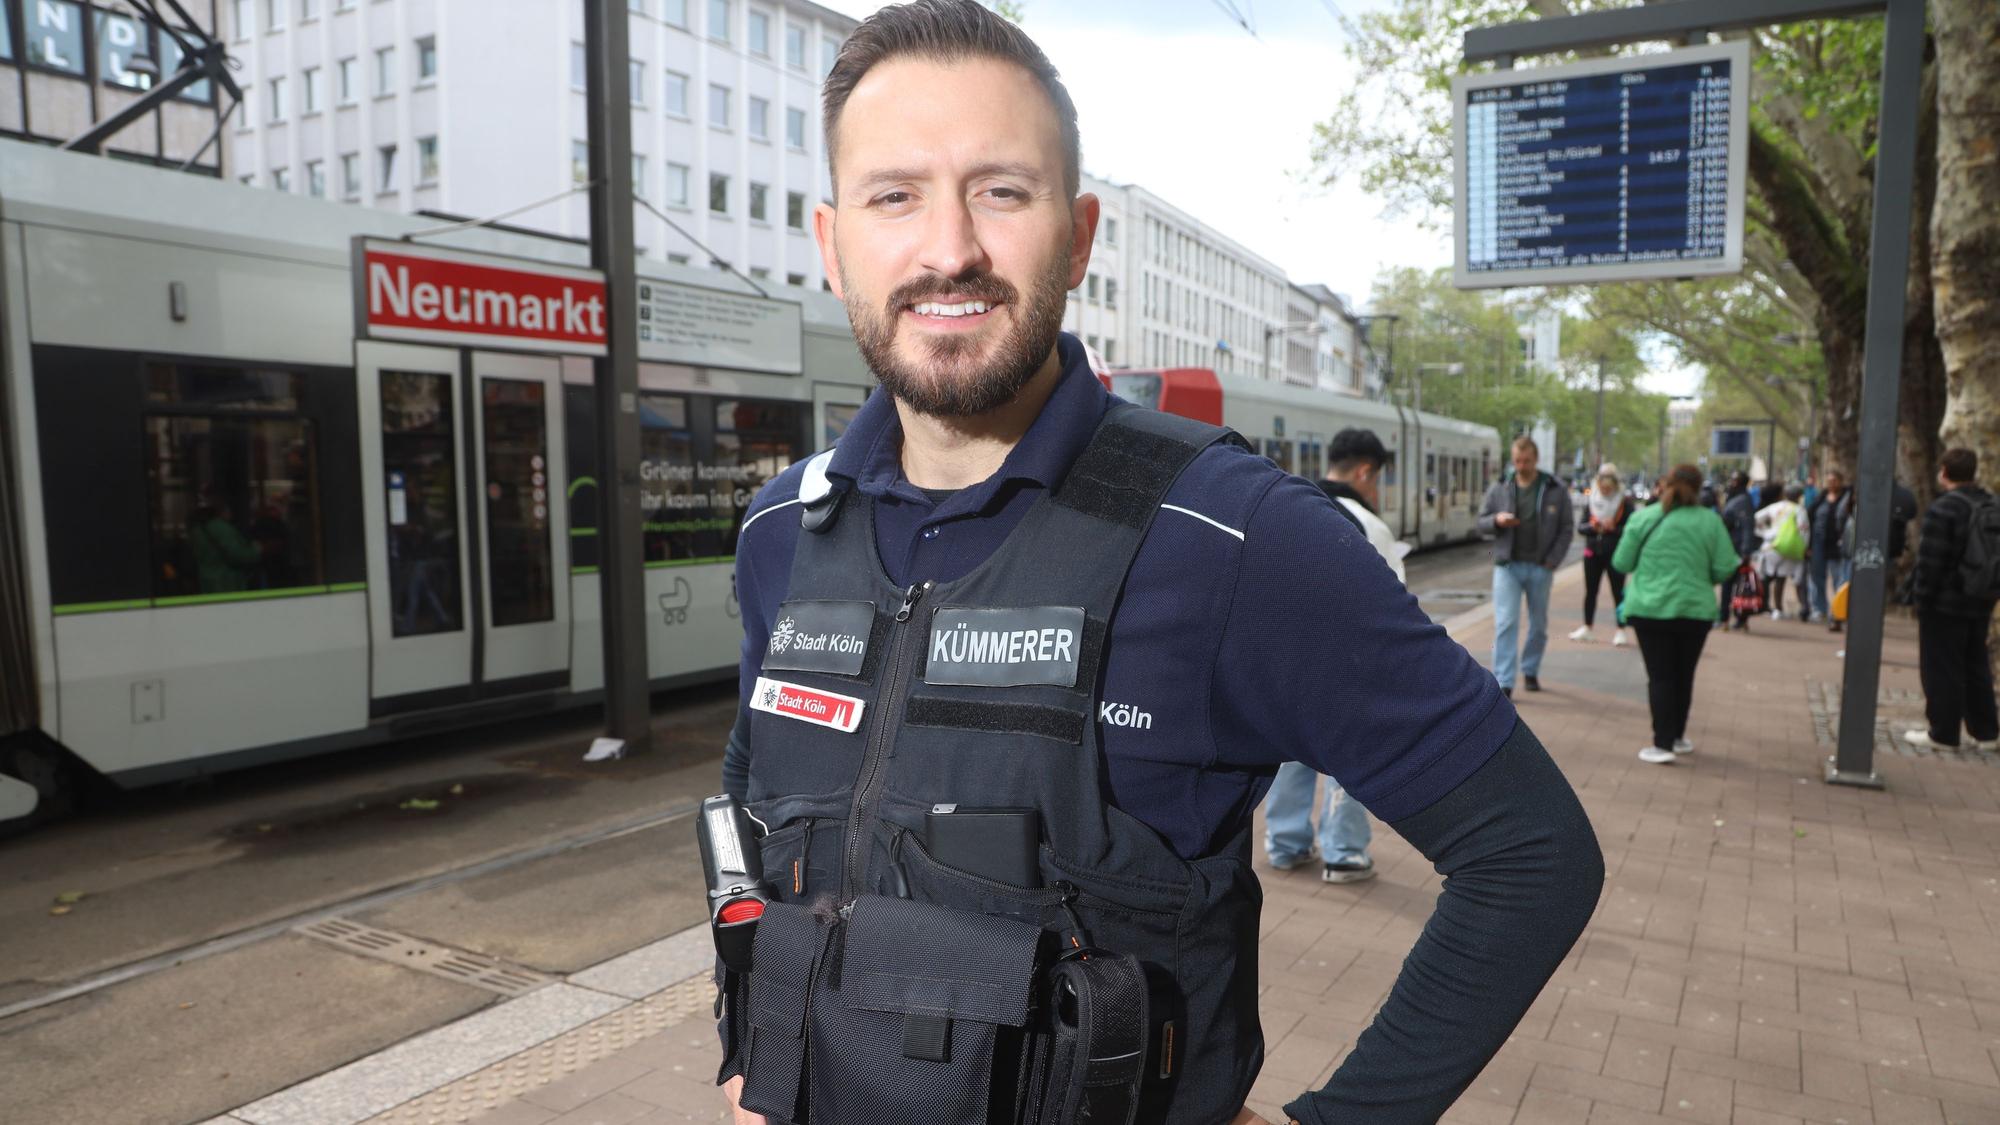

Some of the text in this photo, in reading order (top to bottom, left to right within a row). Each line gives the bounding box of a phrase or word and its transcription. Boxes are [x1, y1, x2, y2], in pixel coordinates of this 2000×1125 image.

[369, 262, 606, 336] Neumarkt
[640, 461, 694, 481] Grüner
[641, 489, 662, 509] ihr
[665, 489, 708, 509] kaum
[710, 488, 732, 508] ins
[794, 633, 864, 655] Stadt Köln
[933, 623, 1073, 663] KÜMMERER
[779, 693, 826, 715] Stadt Köln
[1098, 701, 1152, 729] Köln
